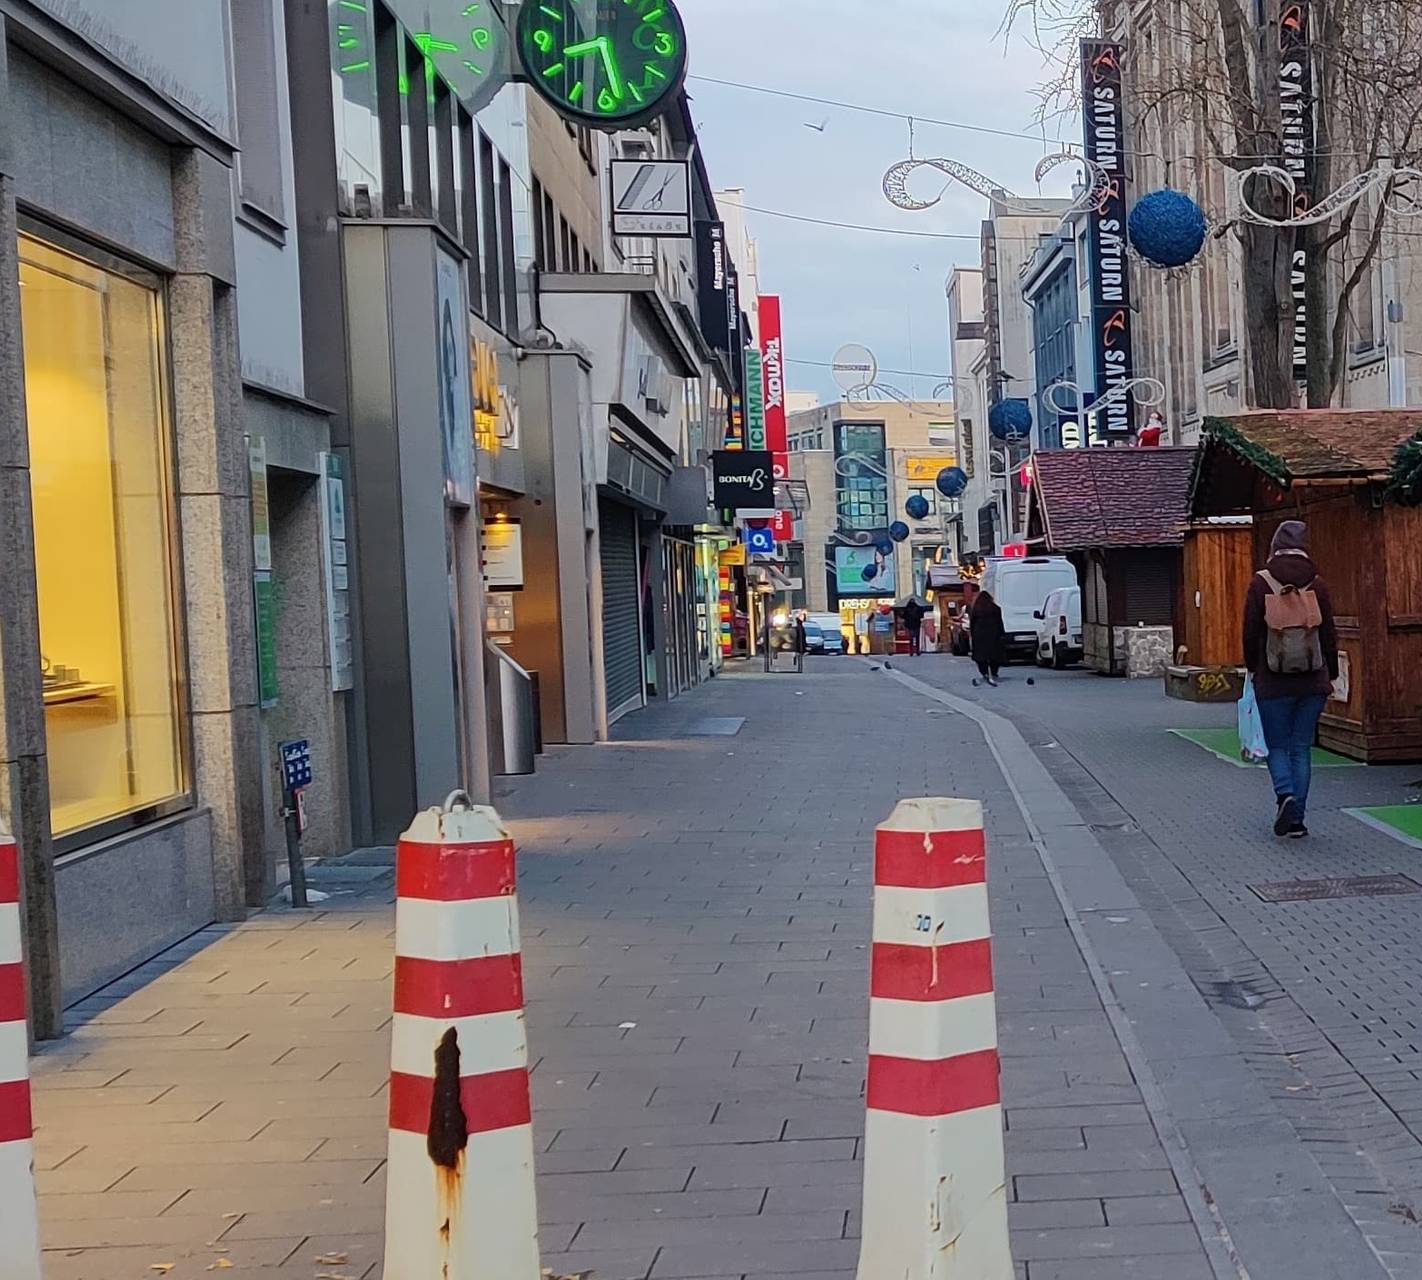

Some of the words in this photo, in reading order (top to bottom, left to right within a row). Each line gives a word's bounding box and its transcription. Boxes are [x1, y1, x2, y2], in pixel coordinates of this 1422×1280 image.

[533, 30, 551, 51] 9
[655, 32, 673, 54] 3
[597, 88, 614, 109] 6
[1094, 86, 1118, 181] SATURN
[1099, 216, 1123, 302] SATURN
[1103, 349, 1128, 432] SATURN
